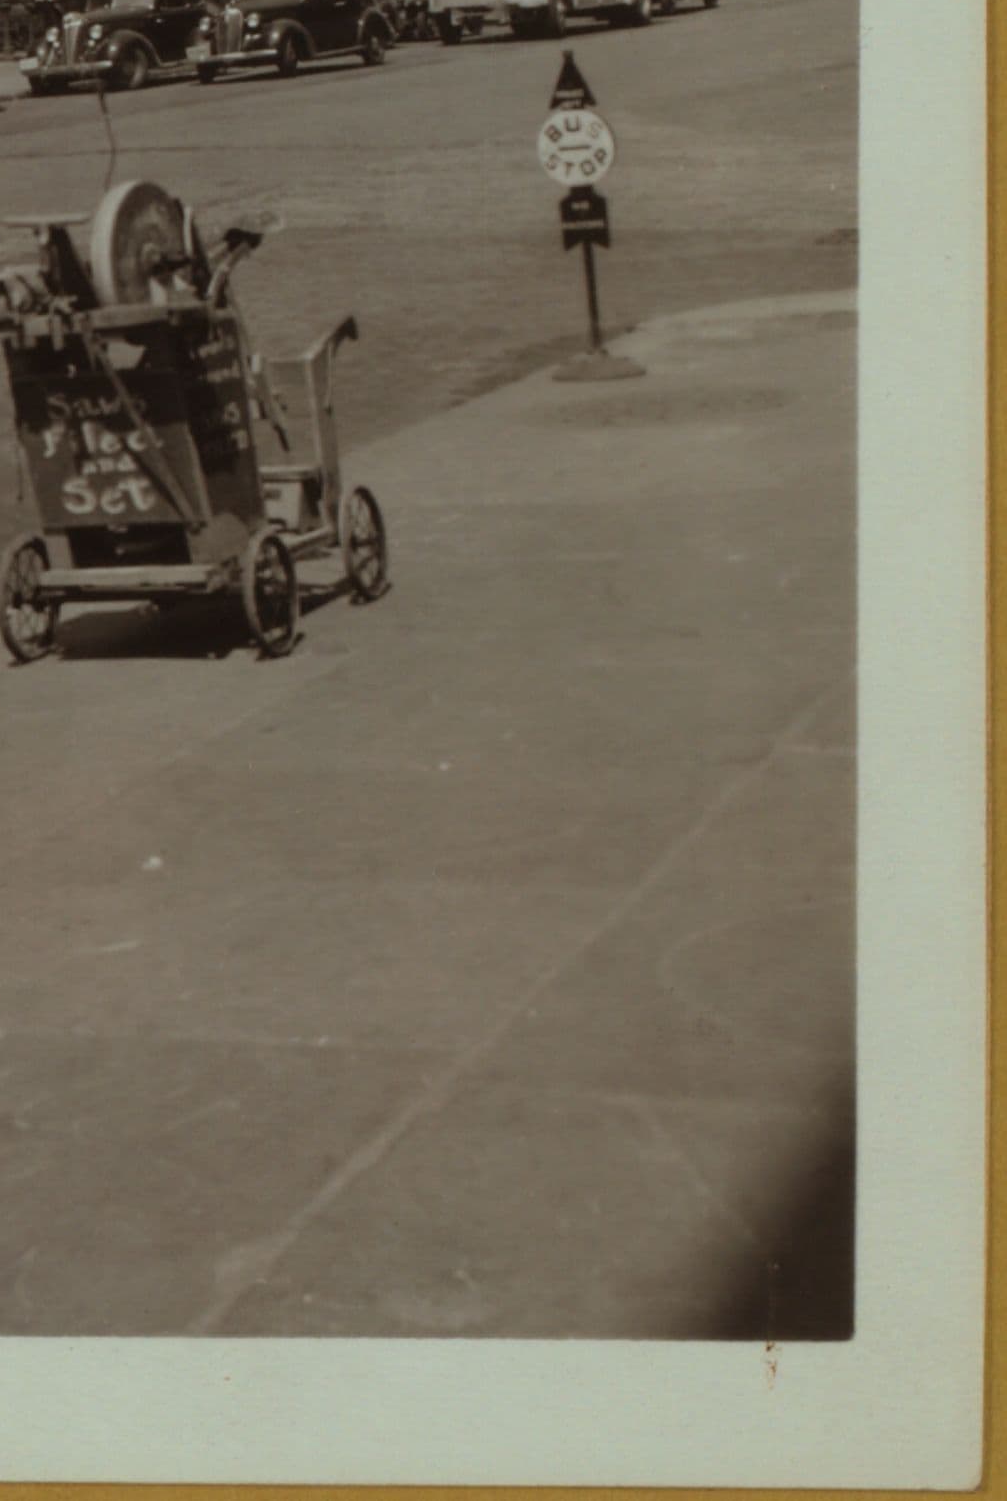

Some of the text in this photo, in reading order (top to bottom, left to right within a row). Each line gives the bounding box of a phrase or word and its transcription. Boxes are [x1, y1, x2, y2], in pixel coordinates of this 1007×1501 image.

[544, 113, 603, 144] BUS
[545, 147, 608, 179] STOP
[62, 477, 155, 515] Set
